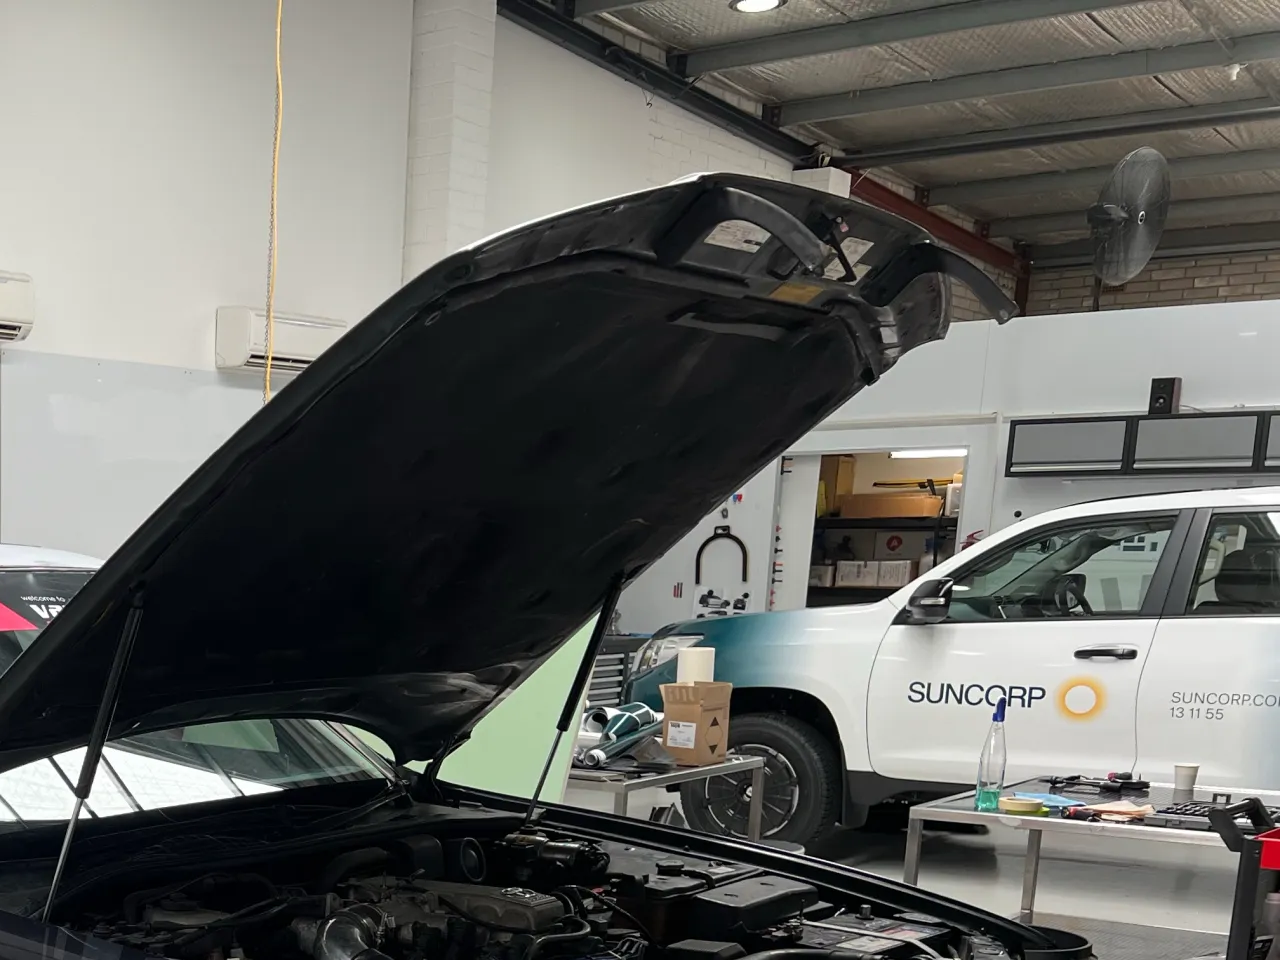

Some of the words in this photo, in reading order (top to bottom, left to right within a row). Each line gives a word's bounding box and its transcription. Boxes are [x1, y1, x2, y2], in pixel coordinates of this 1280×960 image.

[20, 595, 56, 603] welcome
[907, 681, 1047, 708] SUNCORP
[1171, 691, 1280, 707] SUNCORP.CO
[1170, 706, 1185, 719] 13
[1189, 707, 1201, 719] 11
[1205, 707, 1224, 720] 55
